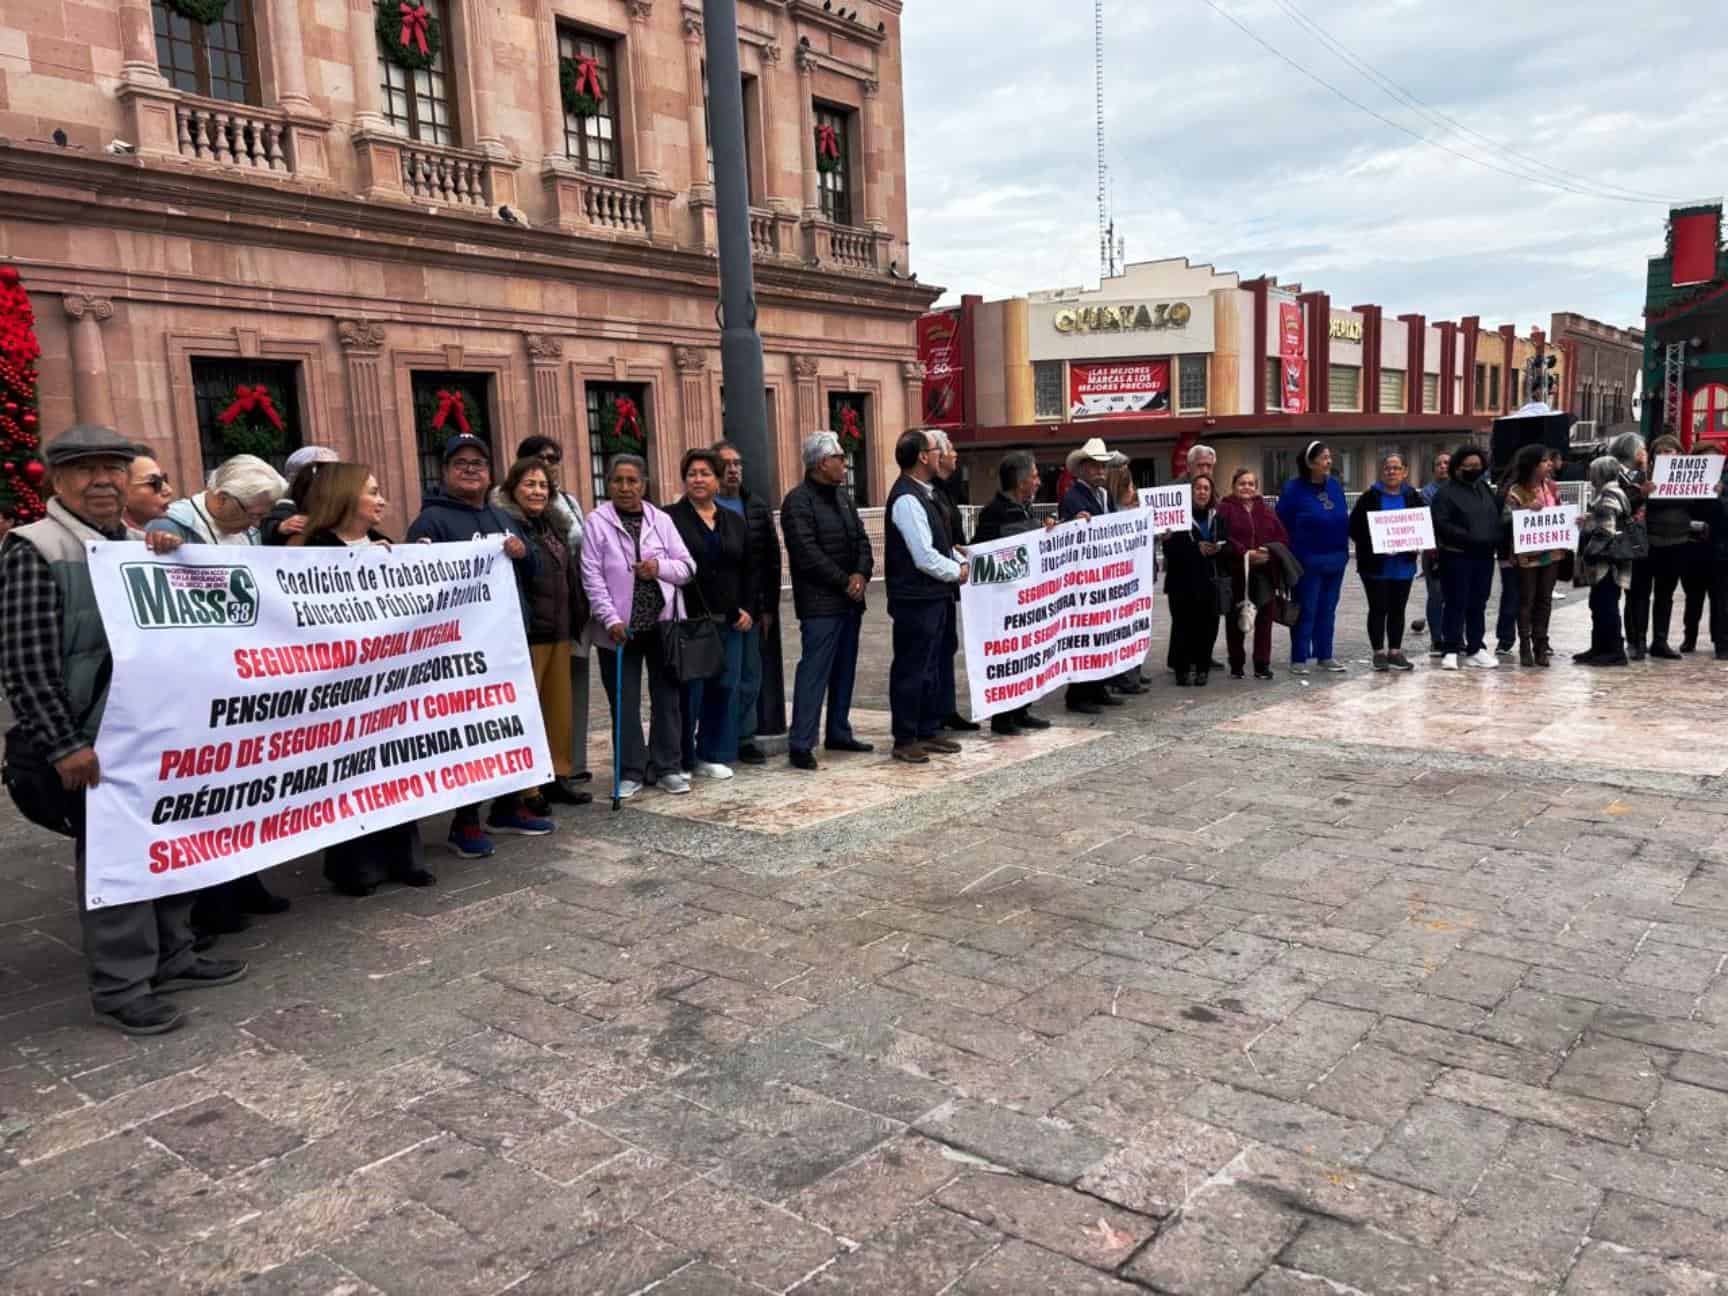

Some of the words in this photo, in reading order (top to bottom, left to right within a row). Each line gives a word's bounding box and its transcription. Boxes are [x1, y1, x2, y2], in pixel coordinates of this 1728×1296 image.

[1088, 375, 1126, 384] MARCAS
[1134, 374, 1151, 382] LOS
[1110, 366, 1150, 375] MEJORES
[1078, 383, 1118, 392] MEJORES
[1670, 458, 1708, 470] RAMOS
[1668, 470, 1705, 483] ARIZPE
[1145, 491, 1182, 508] SALTILLO
[1658, 483, 1710, 496] PRESENTE
[1153, 510, 1184, 526] ESENTE
[1524, 513, 1566, 528] PARRAS
[1520, 530, 1570, 544] PRESENTE
[276, 564, 354, 596] Coalición
[357, 566, 378, 591] de
[380, 558, 472, 589] Trabajadores
[1064, 568, 1100, 588] SOCIAL
[231, 603, 250, 622] 38
[292, 597, 378, 627] Educación
[376, 591, 434, 619] Pública
[1004, 604, 1048, 630] PENSION
[1080, 592, 1087, 606] Y
[1090, 589, 1108, 605] SIN
[984, 636, 1018, 656] PAGO
[1022, 632, 1032, 650] DE
[1062, 616, 1067, 630] A
[1069, 609, 1112, 628] TIEMPO
[234, 640, 356, 679] SEGURIDAD
[359, 632, 409, 664] SOCIAL
[408, 620, 462, 654] INTEGRAL
[986, 652, 1042, 680] CRÉDITOS
[1056, 634, 1090, 652] TENER
[1094, 626, 1132, 647] VIVIENDA
[984, 677, 1034, 704] SERVICIO
[1062, 658, 1068, 673] A
[1070, 652, 1113, 672] TIEMPO
[209, 688, 308, 728] PENSION
[310, 676, 370, 710] SEGURA
[372, 672, 383, 697] Y
[383, 667, 408, 694] SIN
[408, 652, 488, 686] RECORTES
[158, 742, 232, 781] PAGO
[236, 736, 266, 768] DE
[268, 718, 342, 761] SEGURO
[344, 717, 356, 742] A
[358, 702, 408, 738] TIEMPO
[410, 698, 420, 722] Y
[423, 682, 516, 719] COMPLETO
[152, 775, 277, 826] CRÉDITOS
[280, 762, 329, 799] PARA
[332, 747, 376, 783] TENER
[380, 727, 463, 768] VIVIENDA
[463, 714, 525, 747] DIGNA
[149, 820, 256, 874] SERVICIO
[260, 798, 336, 844] MÉDICO
[338, 793, 354, 819] A
[352, 774, 424, 814] TIEMPO
[424, 770, 439, 794] Y
[440, 746, 534, 790] COMPLETO
